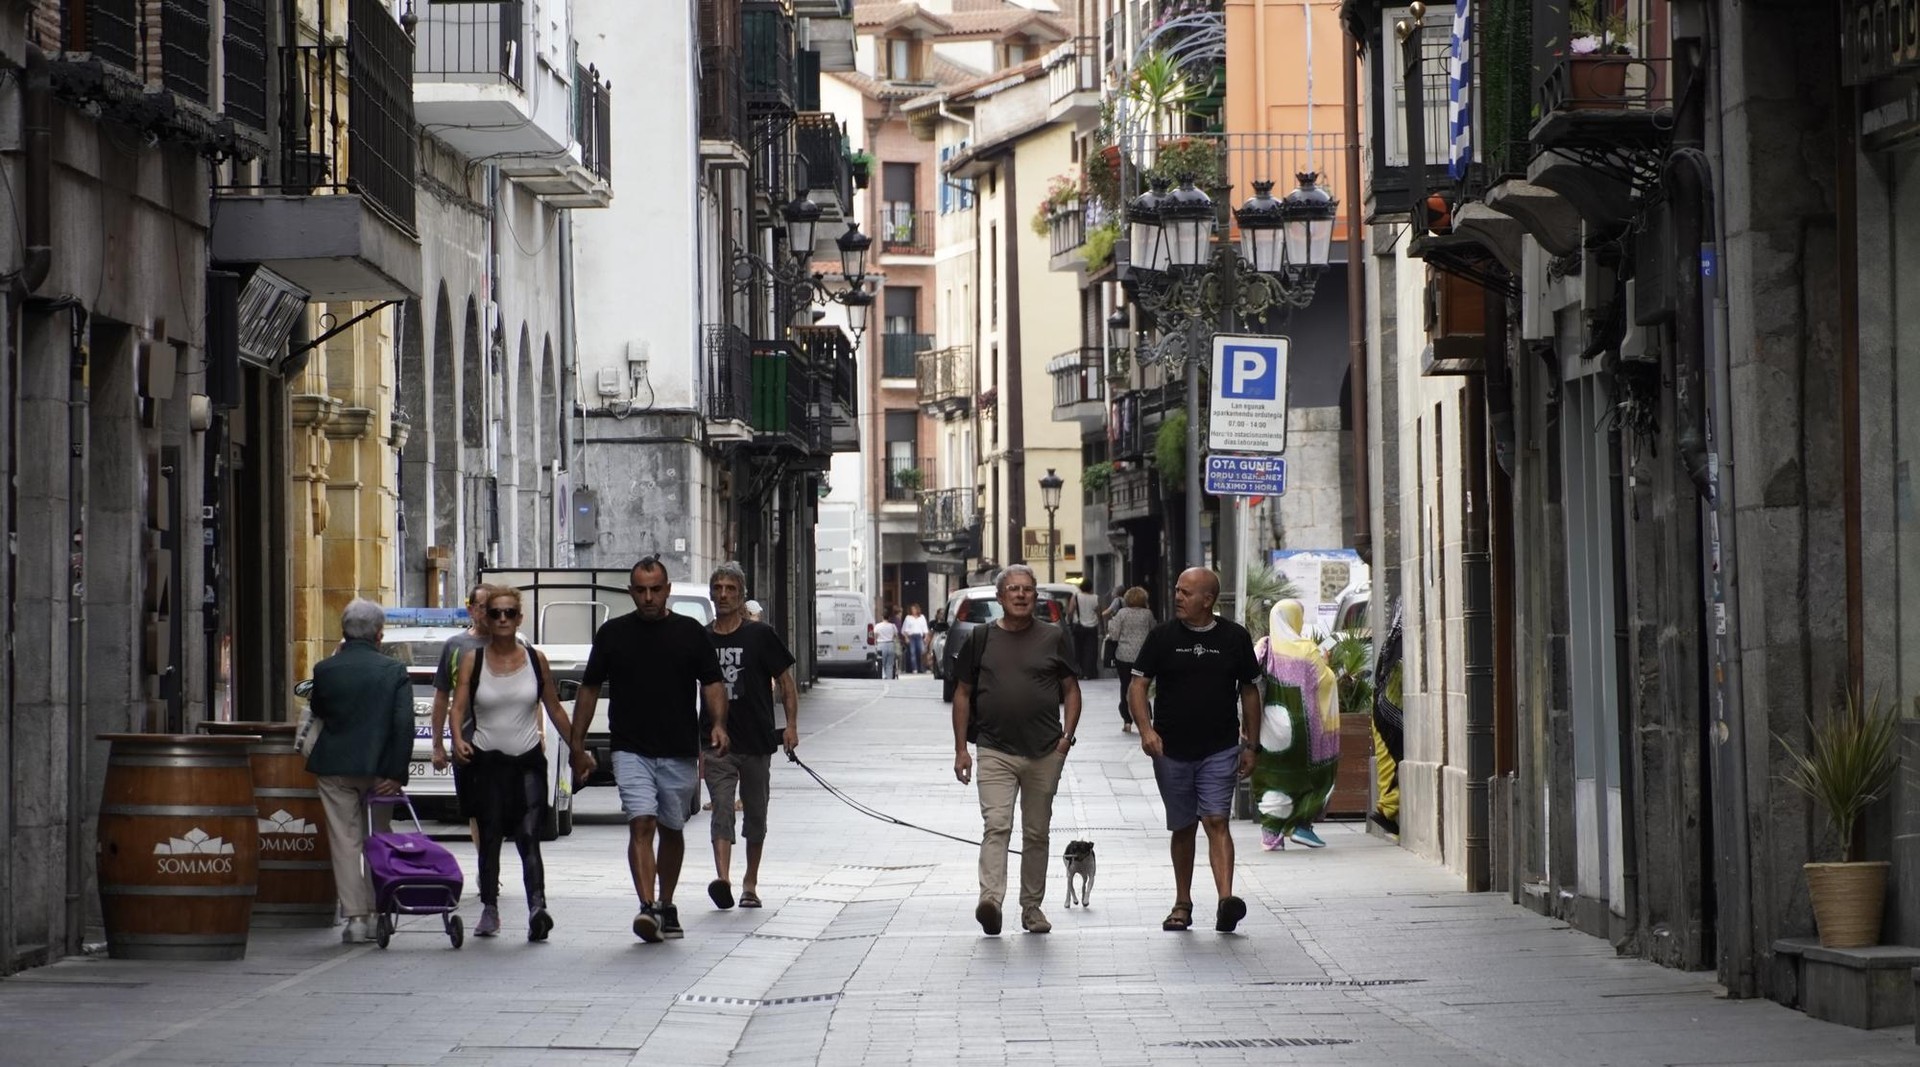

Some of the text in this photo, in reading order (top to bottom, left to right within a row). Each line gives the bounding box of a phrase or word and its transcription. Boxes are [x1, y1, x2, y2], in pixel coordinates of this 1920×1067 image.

[1232, 350, 1267, 393] P
[1212, 459, 1281, 471] OTA GUNEA
[1210, 471, 1234, 479] ORDU
[259, 837, 314, 852] OMMOS
[157, 858, 232, 874] SOMMOS
